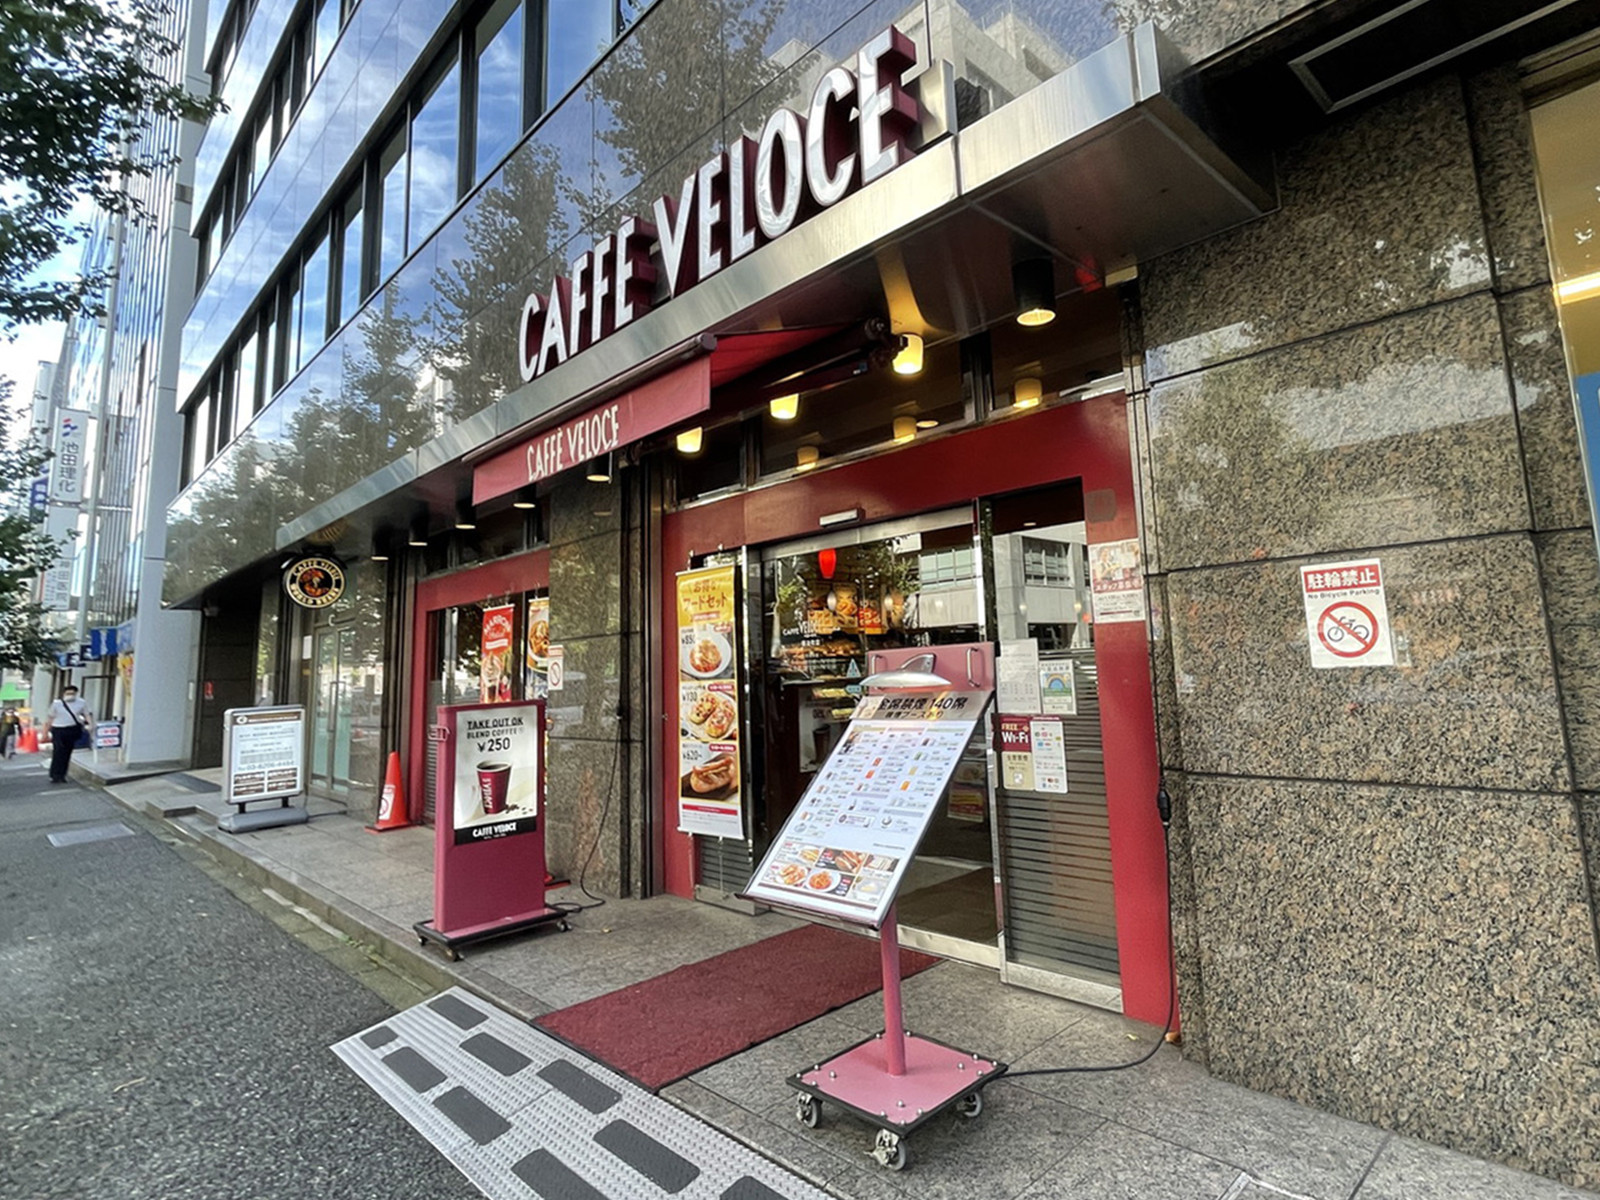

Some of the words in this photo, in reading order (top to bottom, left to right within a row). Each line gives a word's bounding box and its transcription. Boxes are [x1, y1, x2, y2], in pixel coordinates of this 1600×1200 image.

[653, 24, 910, 300] VELOCE
[566, 404, 620, 463] VELOCE
[1306, 567, 1377, 590] 駐輪禁止
[682, 592, 728, 613] フードセット
[1319, 590, 1348, 600] Bicycle
[1349, 588, 1381, 598] Parking
[467, 720, 490, 731] TAKE
[491, 717, 509, 728] OUT
[511, 716, 524, 727] OK
[466, 730, 490, 740] BLEND
[491, 726, 517, 738] COFFEE
[1001, 730, 1029, 744] Wi-Fi
